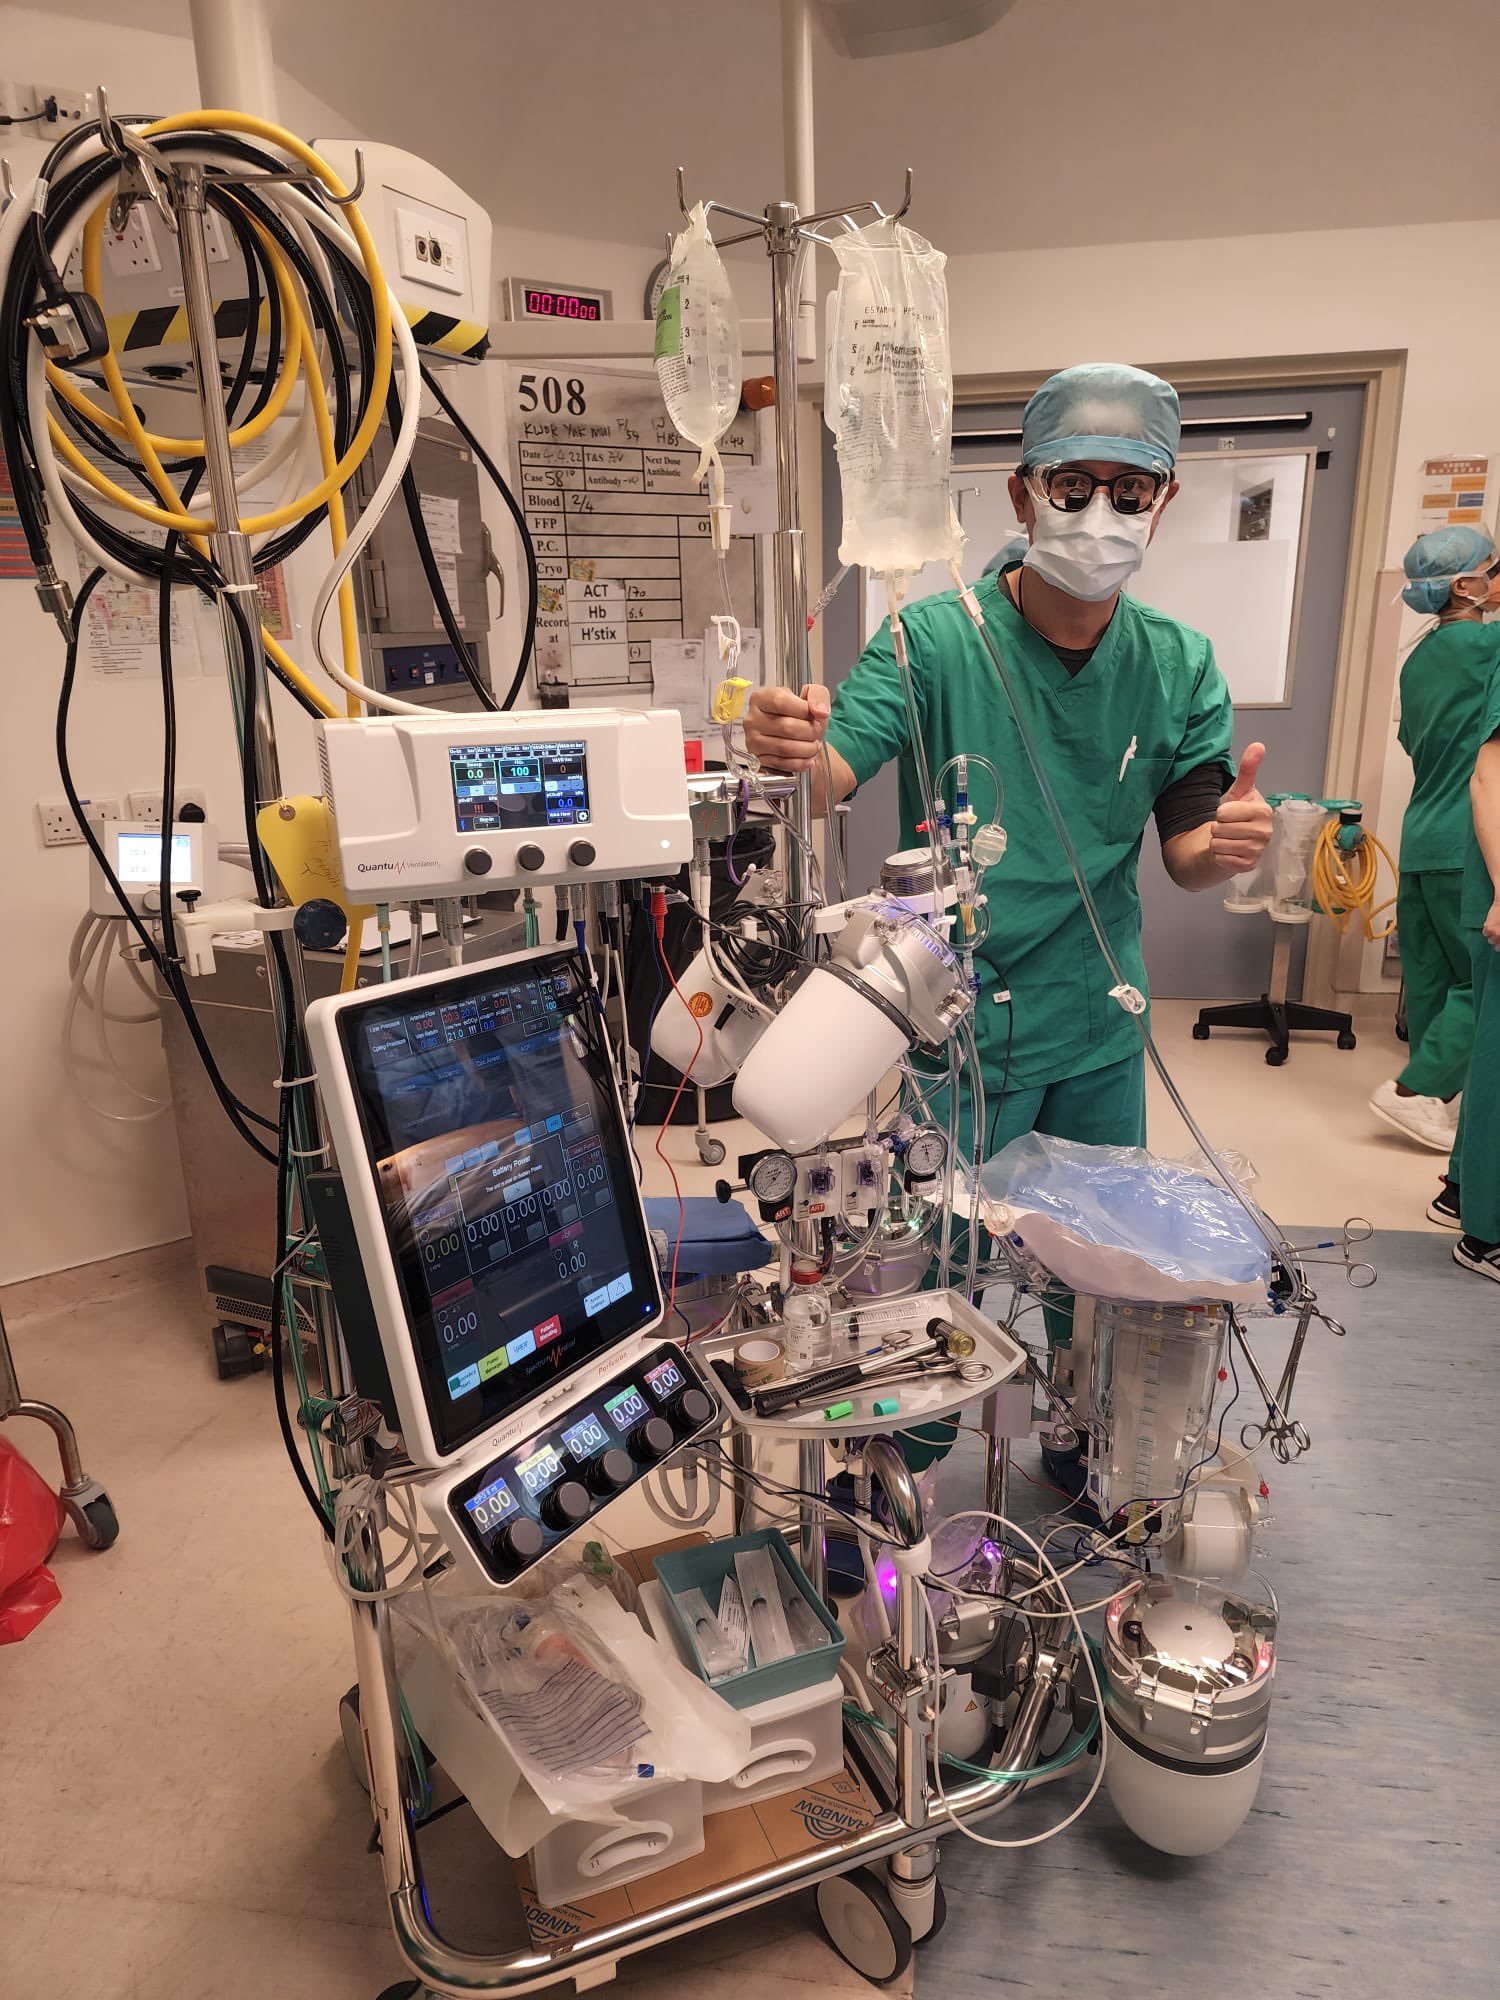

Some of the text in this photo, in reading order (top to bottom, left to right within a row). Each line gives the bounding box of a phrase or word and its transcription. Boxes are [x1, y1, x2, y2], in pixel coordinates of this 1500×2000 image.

[684, 300, 690, 309] 2
[684, 328, 690, 338] 3
[519, 374, 586, 415] 508
[522, 449, 541, 459] Date
[645, 455, 680, 465] Next Dose
[524, 473, 543, 482] Case
[647, 468, 681, 477] Antibiotic
[587, 475, 621, 487] Antibody
[528, 494, 560, 507] Blood
[571, 494, 594, 513] 2/4
[534, 518, 557, 529] FFP
[537, 540, 559, 552] P.C.
[536, 562, 562, 577] Cryo
[583, 585, 609, 598] ACT
[628, 586, 646, 600] 170
[588, 605, 607, 618] Hb
[549, 634, 559, 643] at
[581, 627, 617, 640] H'stix
[467, 769, 484, 779] 0.0
[510, 766, 530, 777] 100
[558, 798, 574, 808] 0.0
[545, 1001, 557, 1011] 100
[483, 1020, 496, 1030] 0.0
[447, 1029, 464, 1041] 21.0
[492, 1155, 531, 1177] Battery Power
[577, 1164, 604, 1189] 0.00
[543, 1180, 571, 1206] 0.00
[506, 1196, 537, 1224] 0.00
[775, 1207, 791, 1219] ART
[810, 1204, 824, 1212] ART
[467, 1215, 500, 1243] 0.00
[424, 1233, 460, 1264] 0.00
[558, 1252, 587, 1279] 0.00
[443, 1311, 477, 1344] 0.00
[598, 1351, 628, 1377] Perfusion
[651, 1368, 679, 1395] 0.00
[612, 1395, 642, 1423] 0.00
[570, 1424, 602, 1454] 0.00
[524, 1456, 558, 1488] 0.00
[474, 1490, 511, 1524] 0.00
